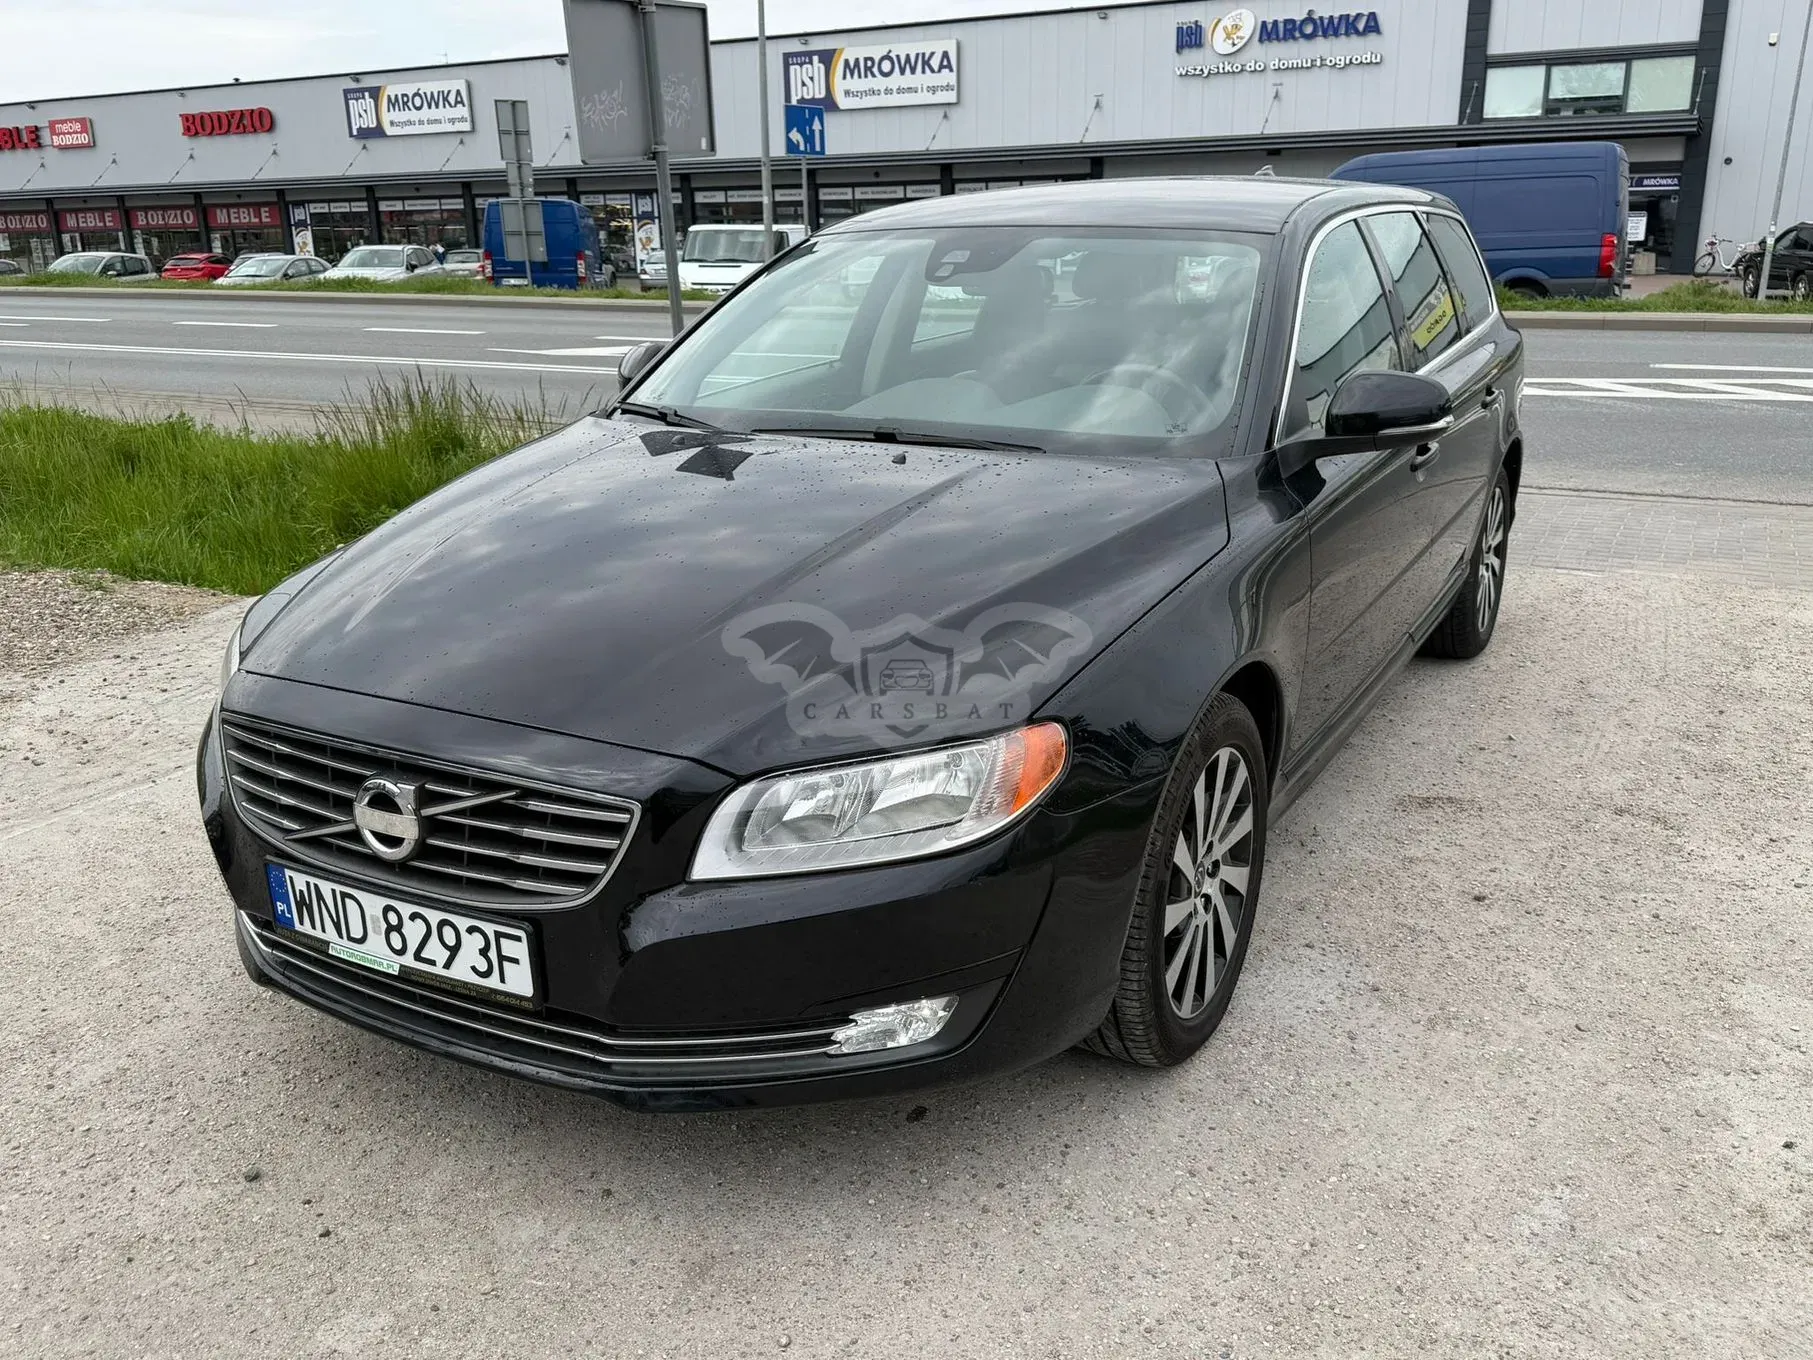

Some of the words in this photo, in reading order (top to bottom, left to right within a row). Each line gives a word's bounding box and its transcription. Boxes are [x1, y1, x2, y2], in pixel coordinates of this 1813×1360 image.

[1258, 9, 1382, 43] MRÓWKA
[842, 50, 953, 80] MRÓWKA
[1175, 61, 1241, 77] wszystko
[1246, 60, 1264, 72] do
[1270, 58, 1311, 70] domu
[1316, 56, 1321, 67] i
[1326, 51, 1381, 68] ogrodu
[790, 56, 826, 104] psb
[843, 86, 881, 99] Wszystko
[883, 86, 894, 96] do
[896, 84, 919, 95] domu
[926, 82, 955, 95] ogrodu
[387, 88, 466, 113] MRÓWKA
[179, 107, 273, 137] BODZIO
[348, 91, 377, 135] psb
[55, 121, 81, 133] meble
[52, 133, 88, 146] BODZIO
[1643, 178, 1679, 186] MRÓWKA
[66, 212, 114, 227] MEBLE
[136, 210, 193, 225] BODZIO
[216, 208, 271, 224] MEBLE
[276, 902, 292, 918] PL
[288, 875, 368, 945] WND
[382, 904, 522, 984] 8293F
